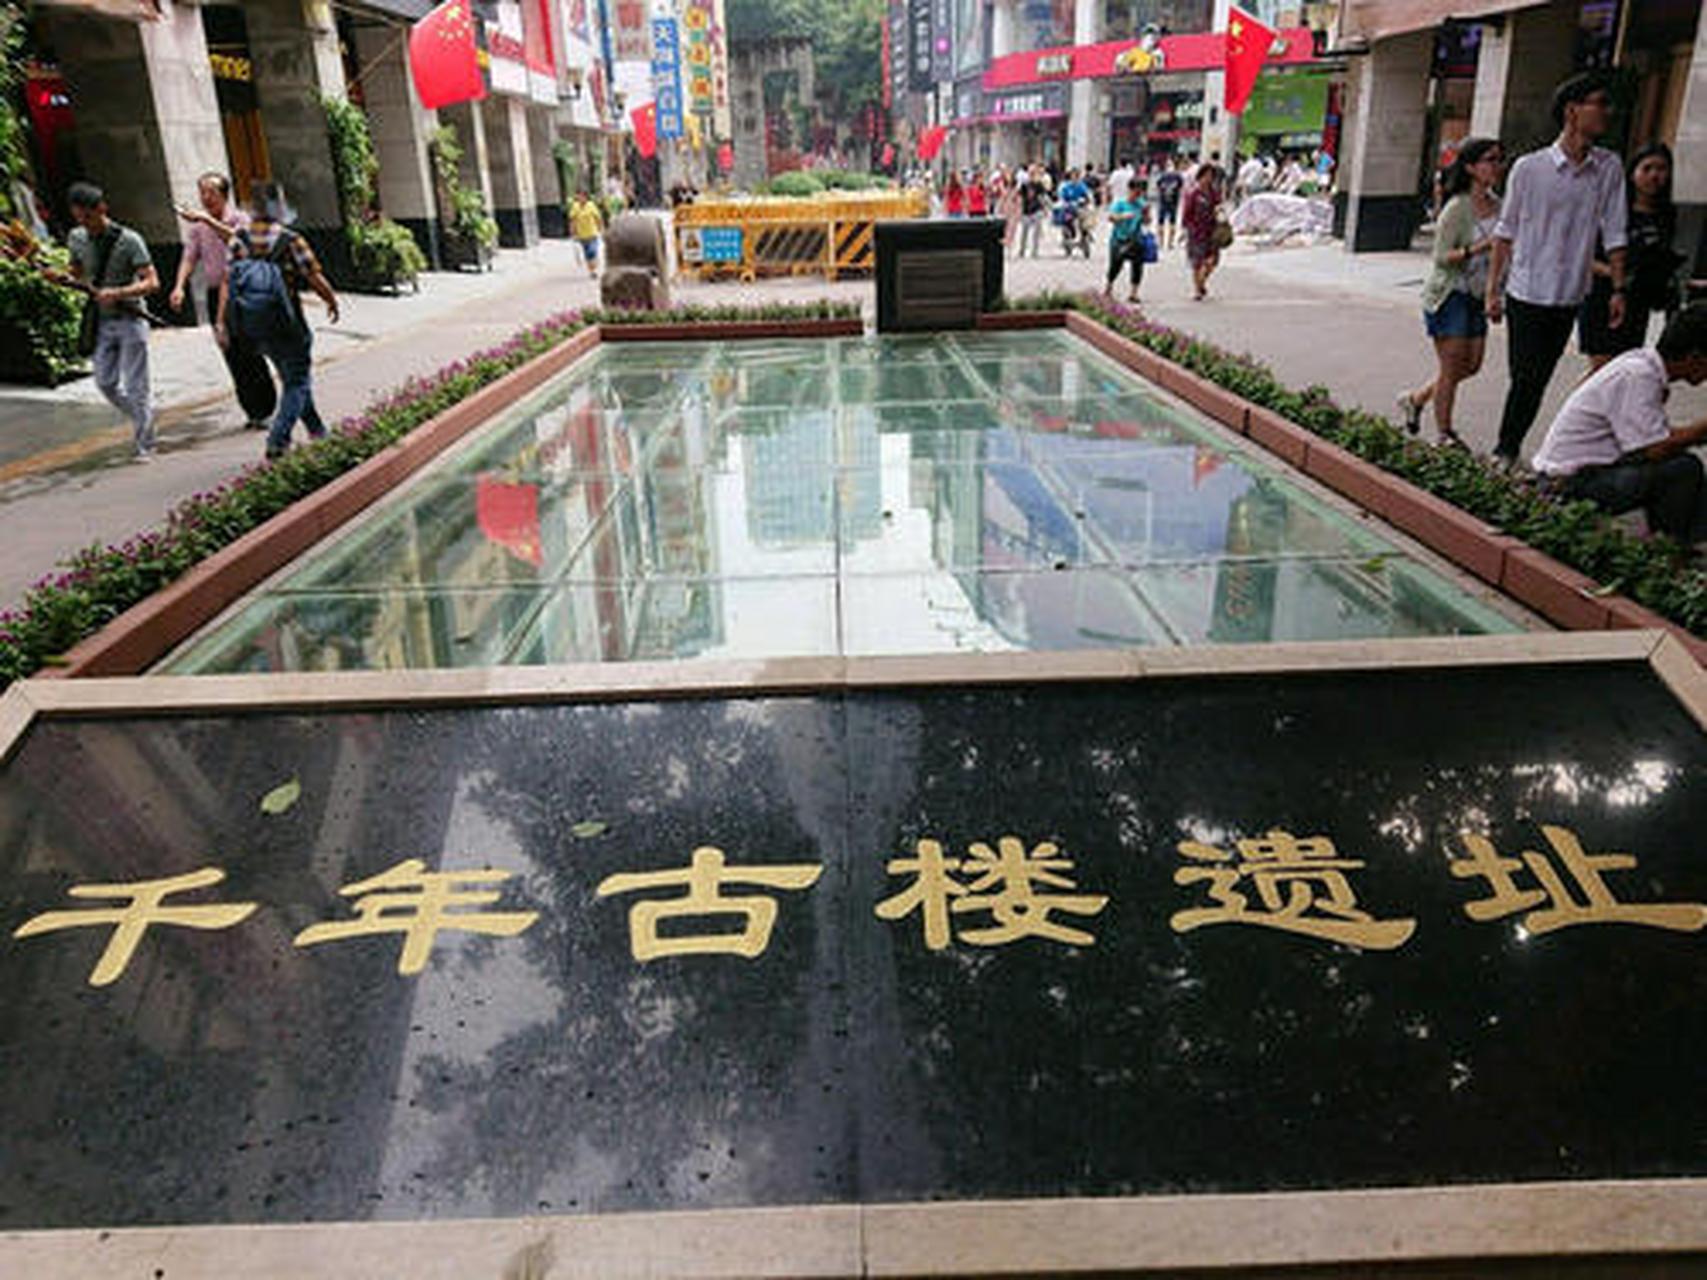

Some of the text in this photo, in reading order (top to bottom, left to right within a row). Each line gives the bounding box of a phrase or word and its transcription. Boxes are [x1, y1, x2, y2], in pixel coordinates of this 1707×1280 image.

[14, 826, 1707, 986] 千年古楼遗址
